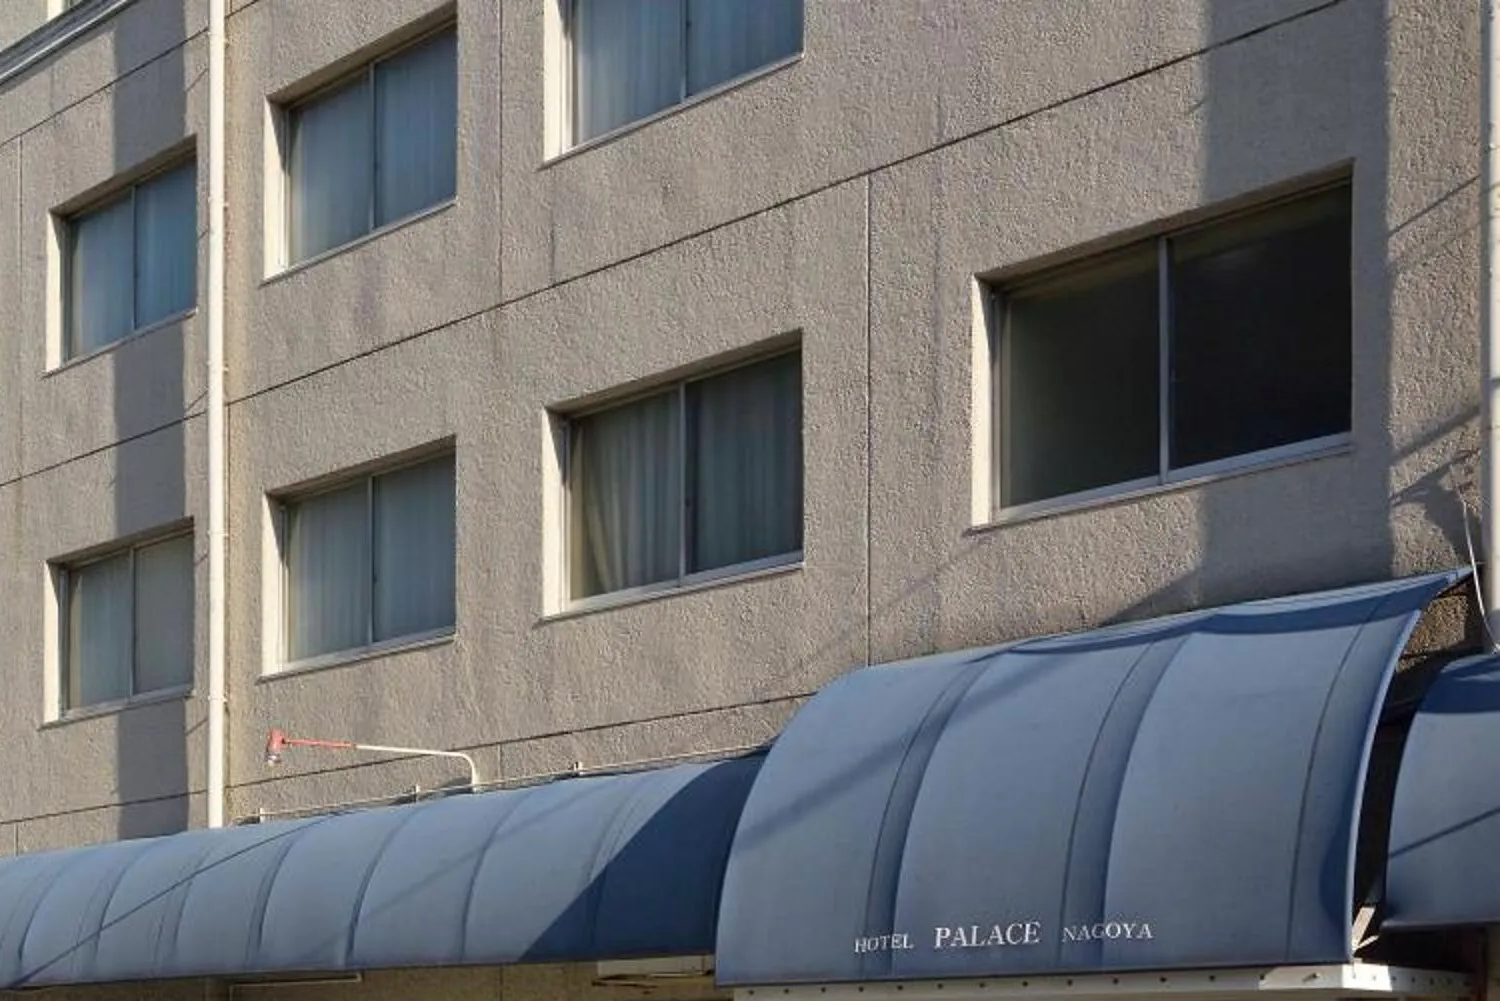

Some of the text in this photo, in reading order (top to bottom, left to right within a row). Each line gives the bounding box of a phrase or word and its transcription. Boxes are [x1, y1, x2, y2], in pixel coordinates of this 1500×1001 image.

[853, 921, 1153, 953] HOTEL PALACE NAGOYA
